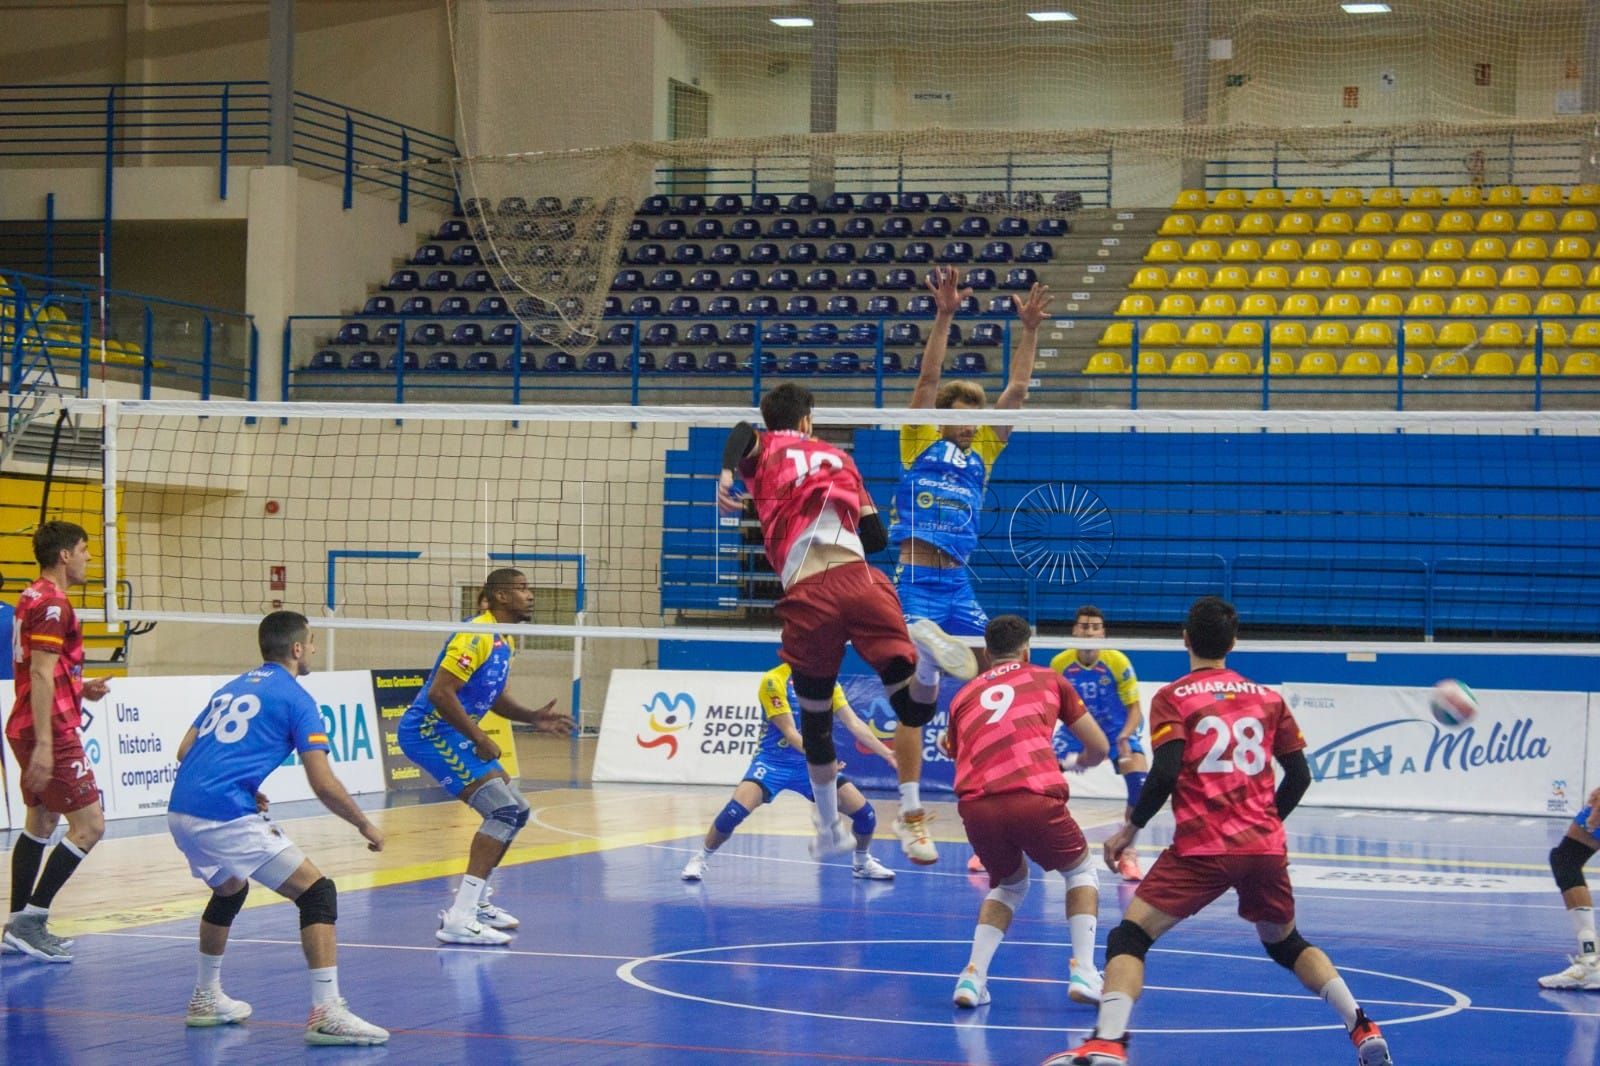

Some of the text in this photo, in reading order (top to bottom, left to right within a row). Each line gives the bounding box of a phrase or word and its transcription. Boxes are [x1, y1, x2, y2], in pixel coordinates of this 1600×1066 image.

[1079, 681, 1098, 699] 13
[1173, 680, 1268, 698] CHIARANTE
[116, 703, 140, 722] Una
[705, 704, 760, 720] MELIL
[980, 684, 1015, 725] 9
[198, 693, 262, 744] 88
[118, 732, 162, 754] historia
[700, 739, 757, 755] CAPIT
[1195, 715, 1266, 776] 28
[1307, 717, 1551, 783] VEN A Melilla
[121, 762, 179, 790] compartid
[753, 766, 767, 780] 8
